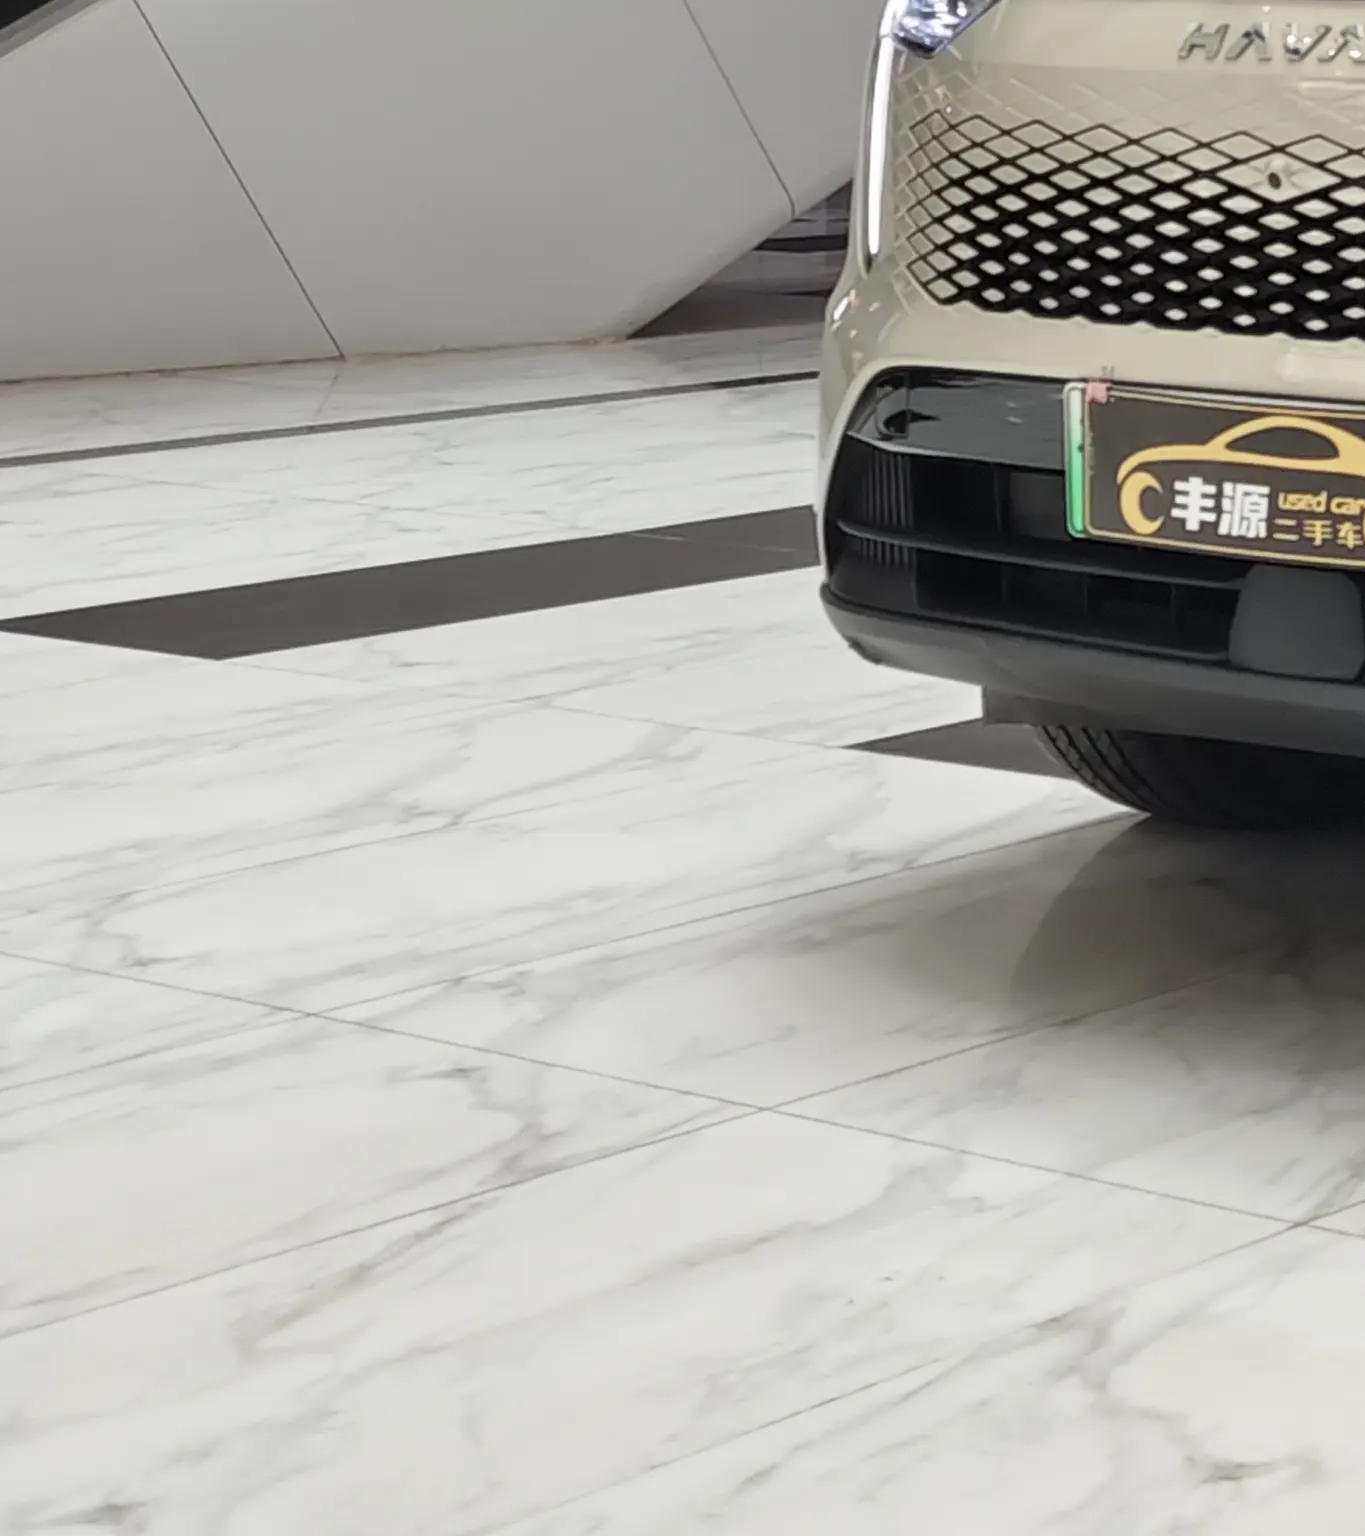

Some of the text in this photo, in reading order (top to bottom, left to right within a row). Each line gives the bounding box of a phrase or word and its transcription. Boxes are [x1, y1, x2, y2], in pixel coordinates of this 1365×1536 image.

[1170, 476, 1271, 539] 丰源
[1277, 490, 1328, 513] used
[1272, 518, 1365, 549] 二手车
